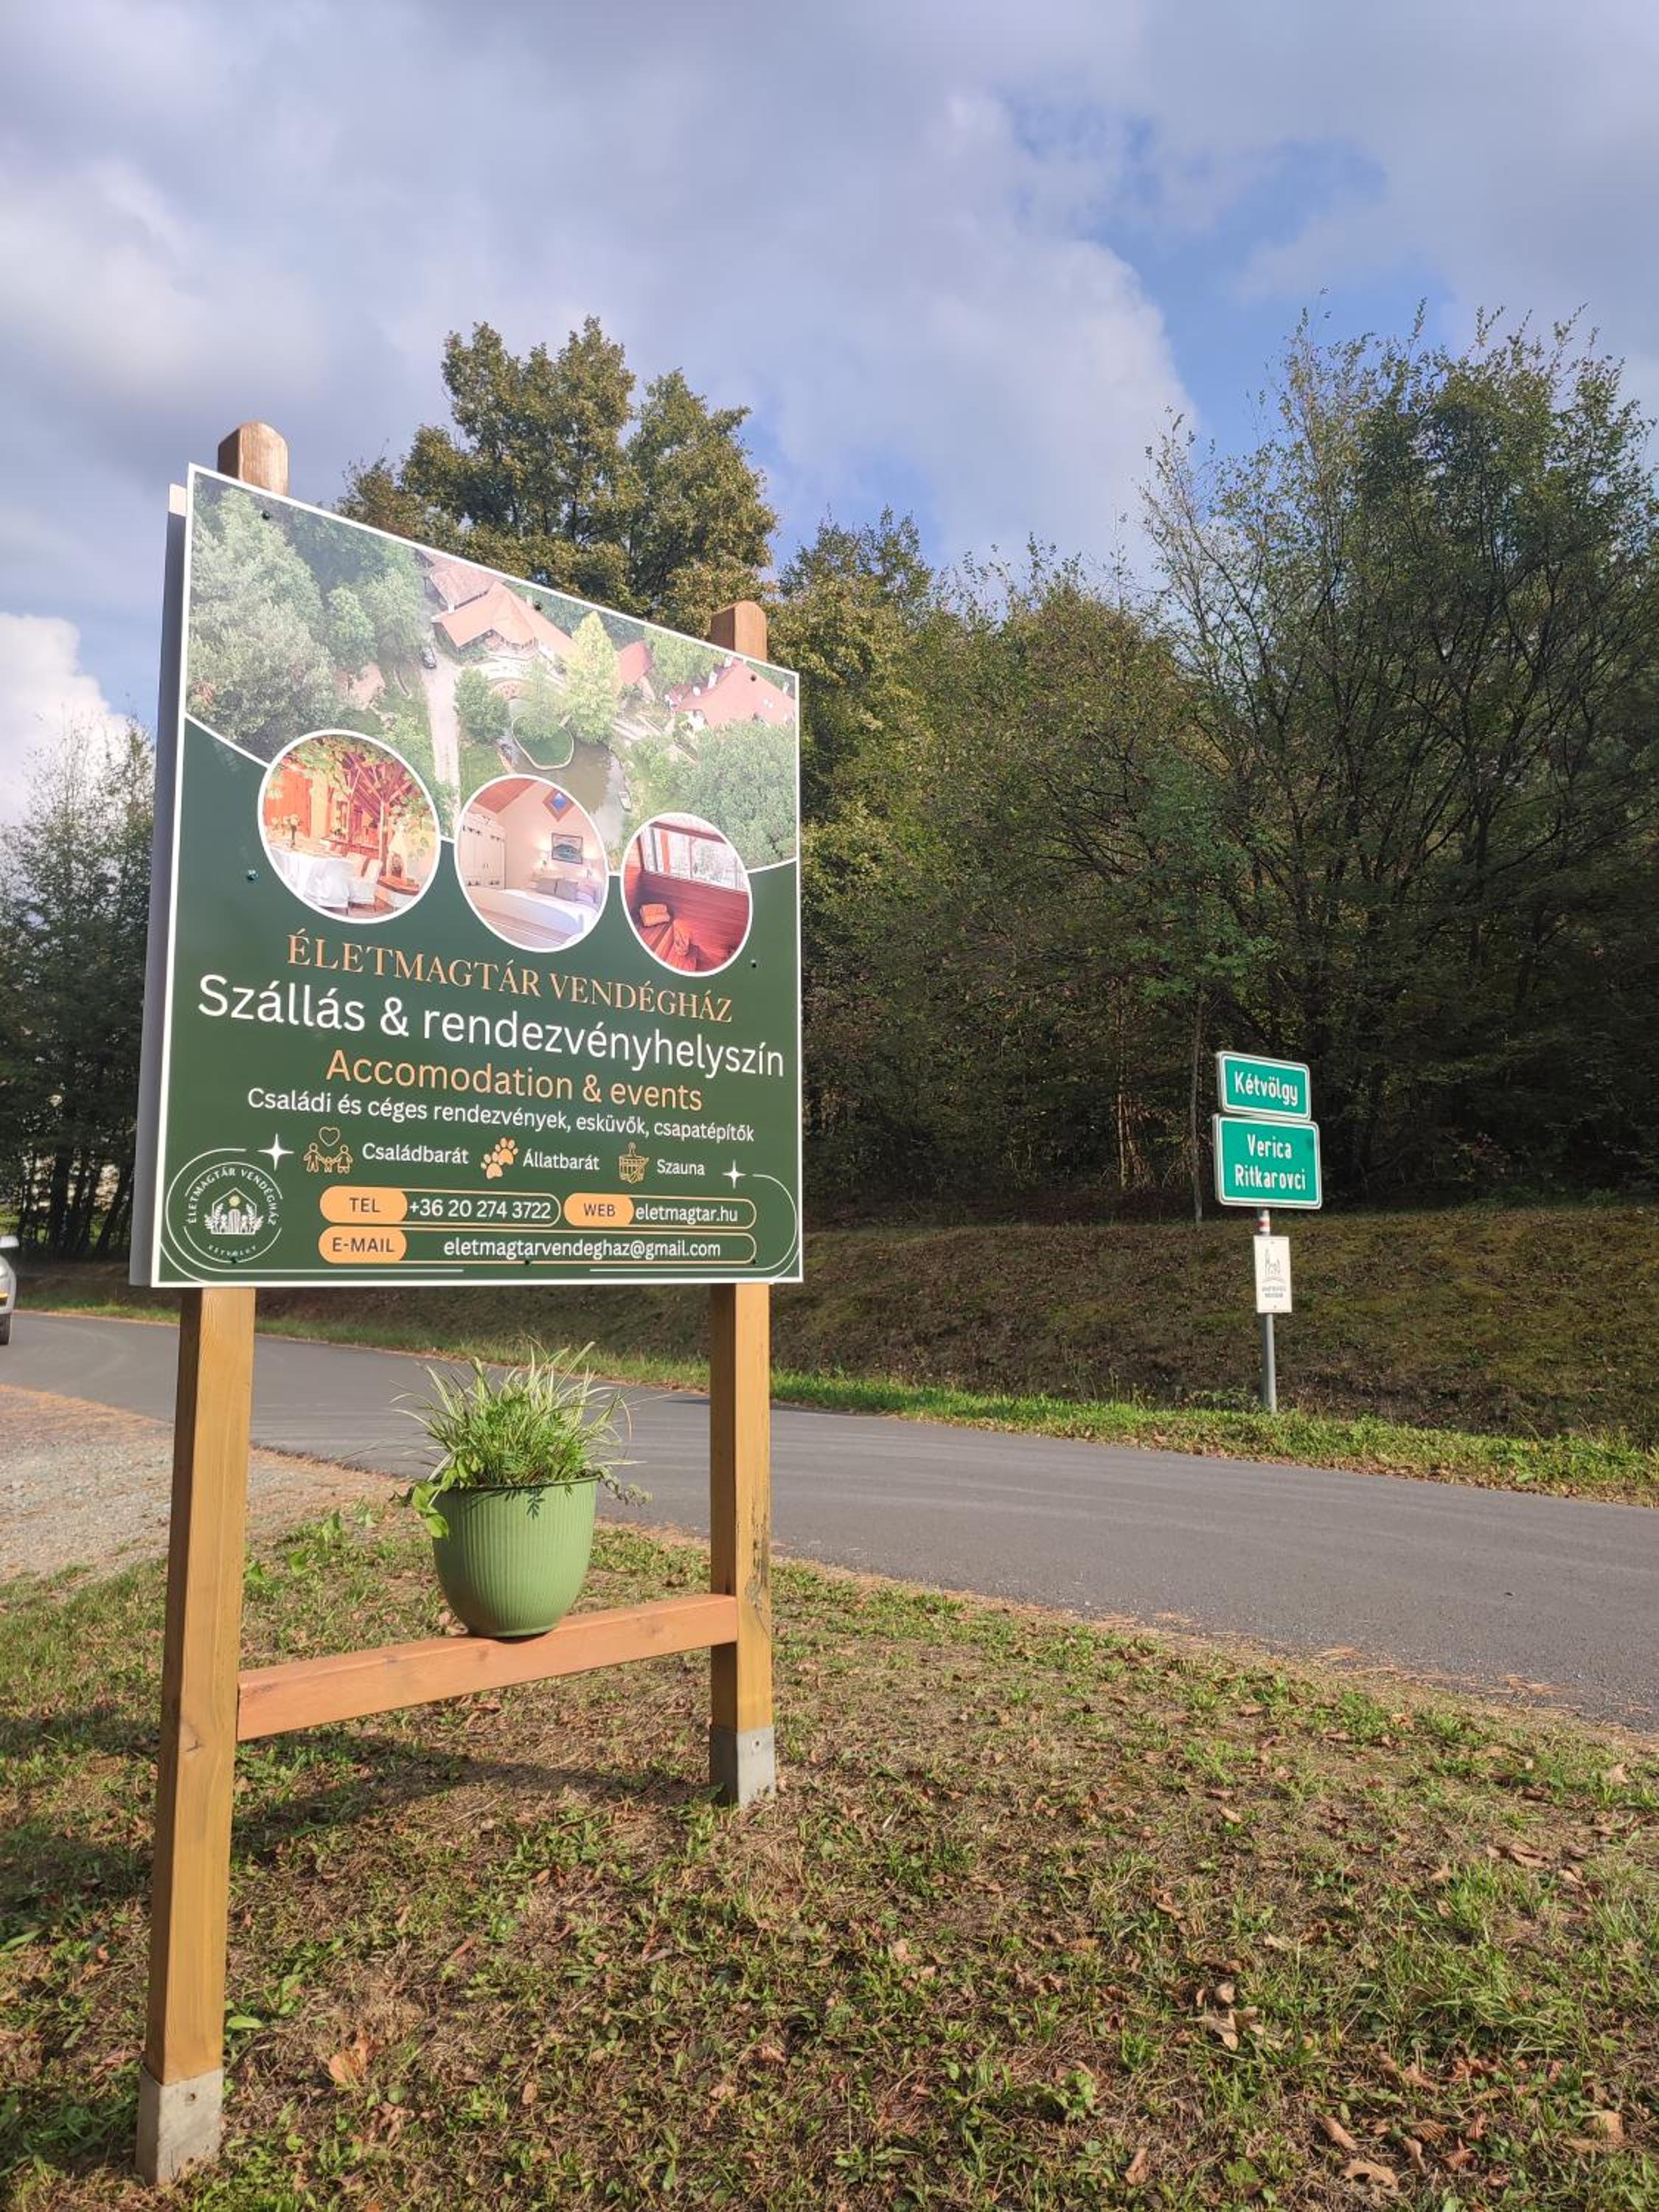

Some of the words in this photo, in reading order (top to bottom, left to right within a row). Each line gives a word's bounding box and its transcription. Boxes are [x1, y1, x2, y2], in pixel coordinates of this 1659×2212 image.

[286, 928, 541, 997] ÉLETMAGTÁR
[549, 973, 733, 1023] VENDÉGHÁZ
[198, 974, 366, 1032] Szállás
[380, 996, 409, 1037] &
[423, 1009, 785, 1079] rendezvényhelyszín
[326, 1049, 573, 1100] Accomodation
[582, 1074, 602, 1103] &
[611, 1081, 703, 1111] events
[1234, 1071, 1298, 1107] Kétvölgy
[248, 1088, 332, 1113] Családi
[338, 1094, 362, 1115] és
[368, 1097, 428, 1123] céges
[434, 1105, 571, 1133] rendezvények,
[576, 1113, 650, 1138] esküvők,
[654, 1121, 755, 1143] csapatépítők
[362, 1142, 470, 1165] Családbarát
[1247, 1133, 1293, 1159] Verica
[522, 1148, 601, 1171] Állatbarát
[657, 1159, 706, 1177] Szauna
[1234, 1164, 1307, 1191] Ritkarovci
[187, 1166, 236, 1224] ÉLETMAGTÁR
[240, 1169, 279, 1225] VENDÉGHÁZ
[349, 1197, 381, 1214] TEL
[409, 1198, 444, 1217] +36
[448, 1199, 472, 1218] 20
[476, 1200, 508, 1218] 274
[512, 1201, 552, 1219] 3722
[584, 1203, 616, 1217] WEB
[636, 1205, 738, 1225] eletmagtar.hu
[333, 1237, 394, 1253] E-MAIL
[443, 1237, 720, 1260] eletmagtarvendeghaz@gmail.com
